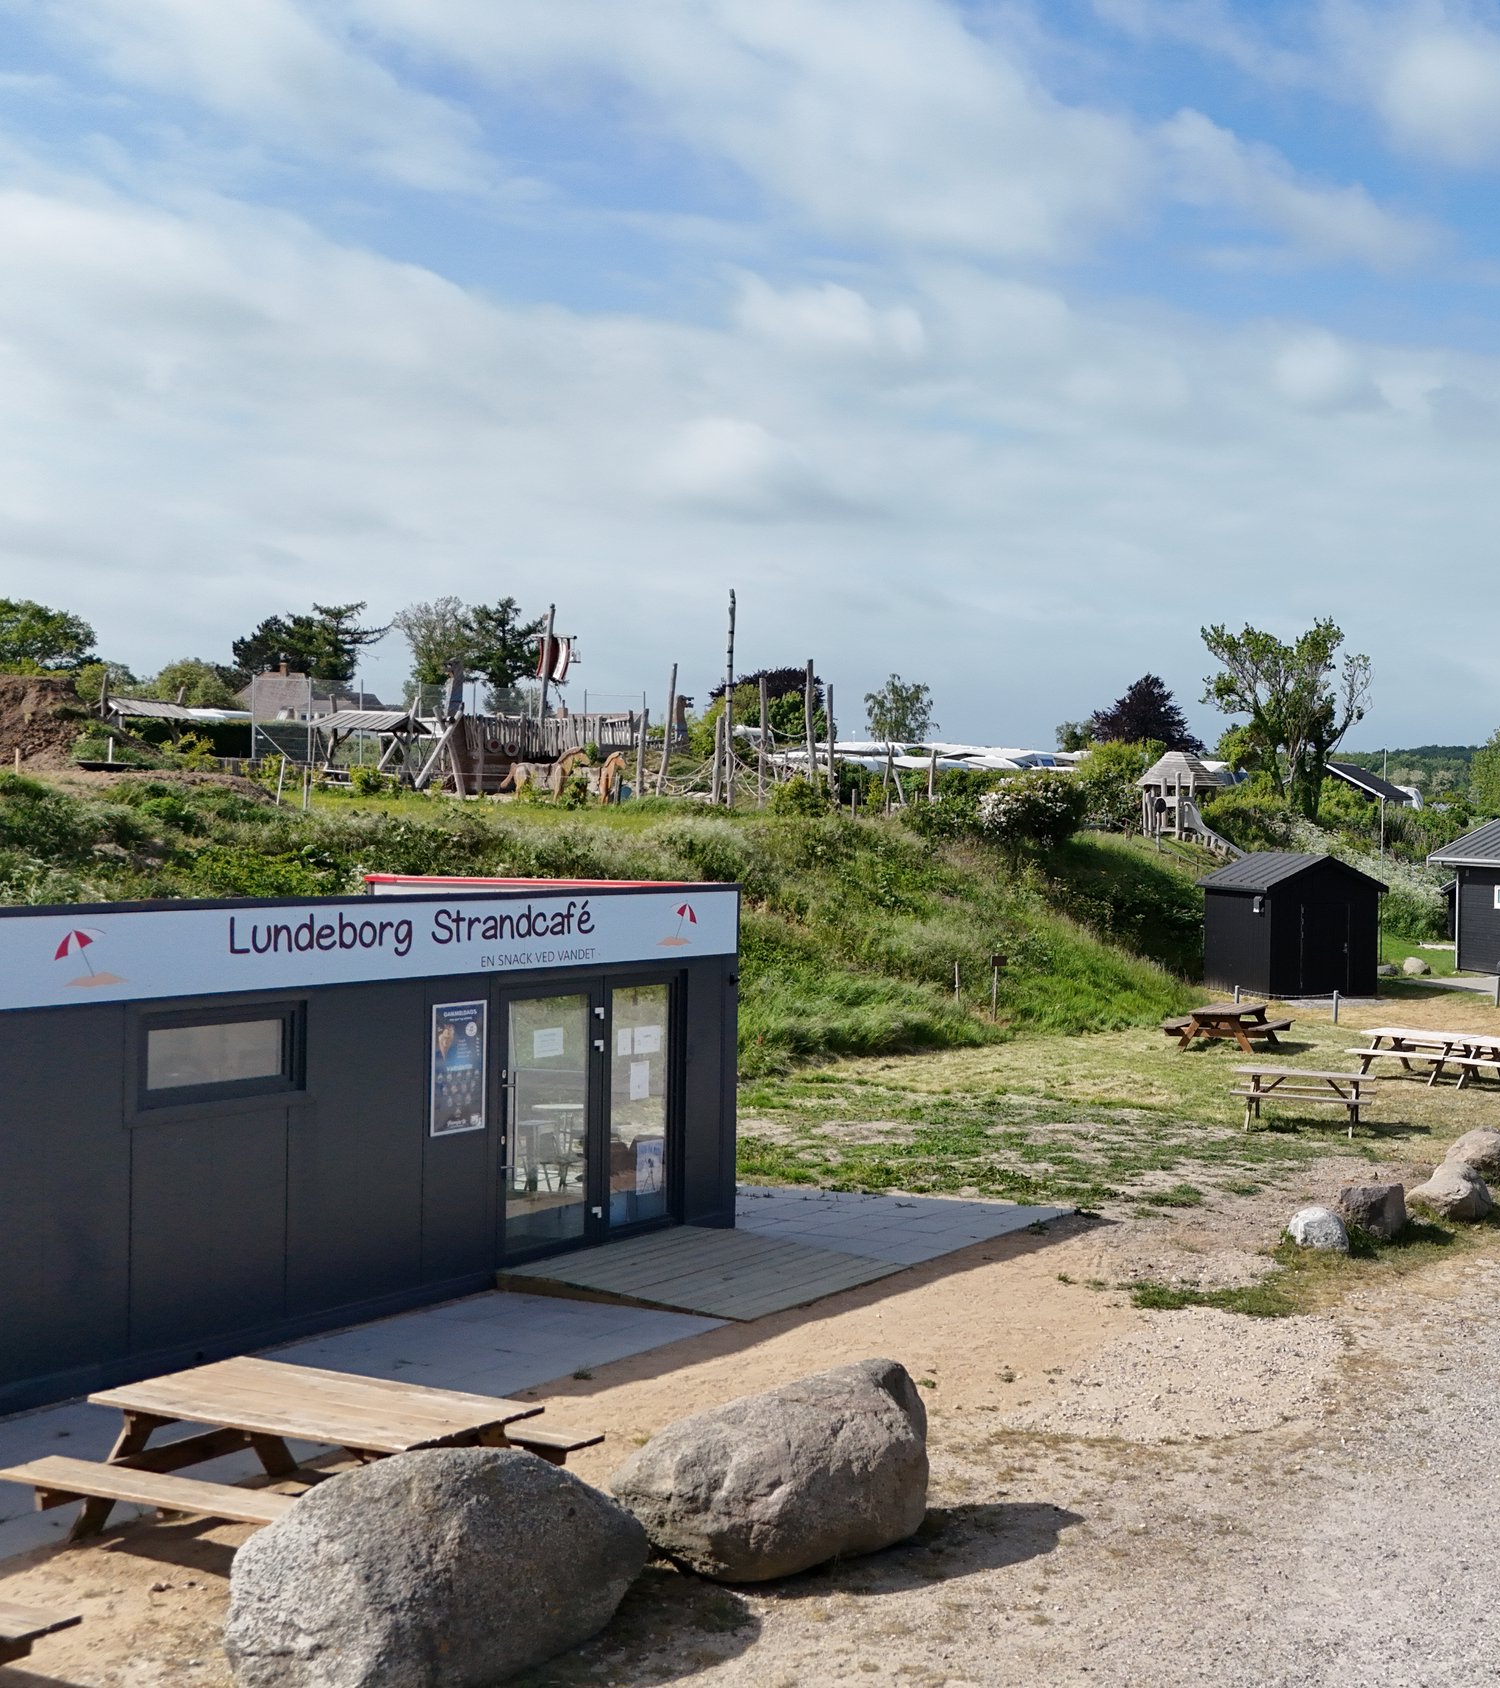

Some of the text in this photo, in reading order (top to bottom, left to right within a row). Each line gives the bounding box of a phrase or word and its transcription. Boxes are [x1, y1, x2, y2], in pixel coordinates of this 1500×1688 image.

[229, 899, 595, 957] Lundeborg Strandcafé
[480, 948, 596, 968] EN SNACK VED VANDET
